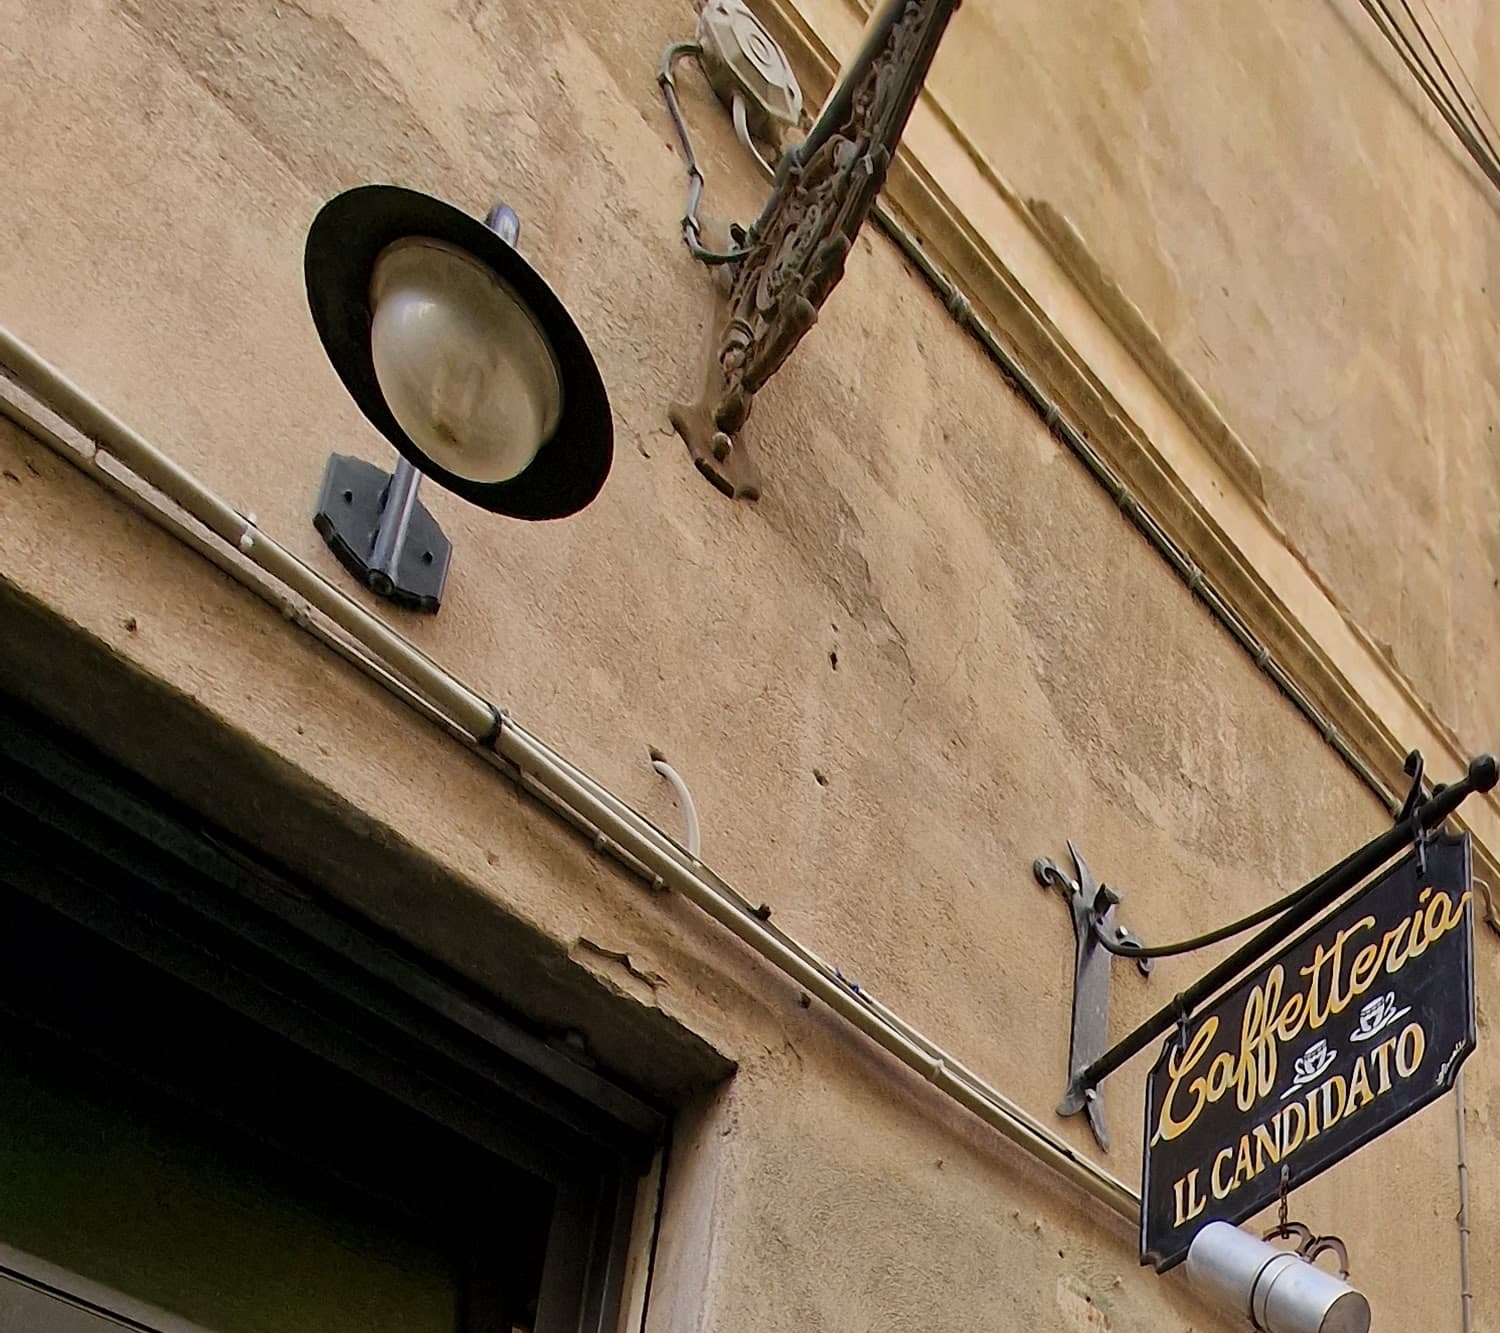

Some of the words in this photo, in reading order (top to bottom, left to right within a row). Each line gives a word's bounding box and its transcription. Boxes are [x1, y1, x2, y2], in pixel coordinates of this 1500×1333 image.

[1151, 887, 1472, 1147] Caffetteria
[1173, 1168, 1207, 1228] IL
[1211, 1022, 1426, 1200] CANDIDATO
